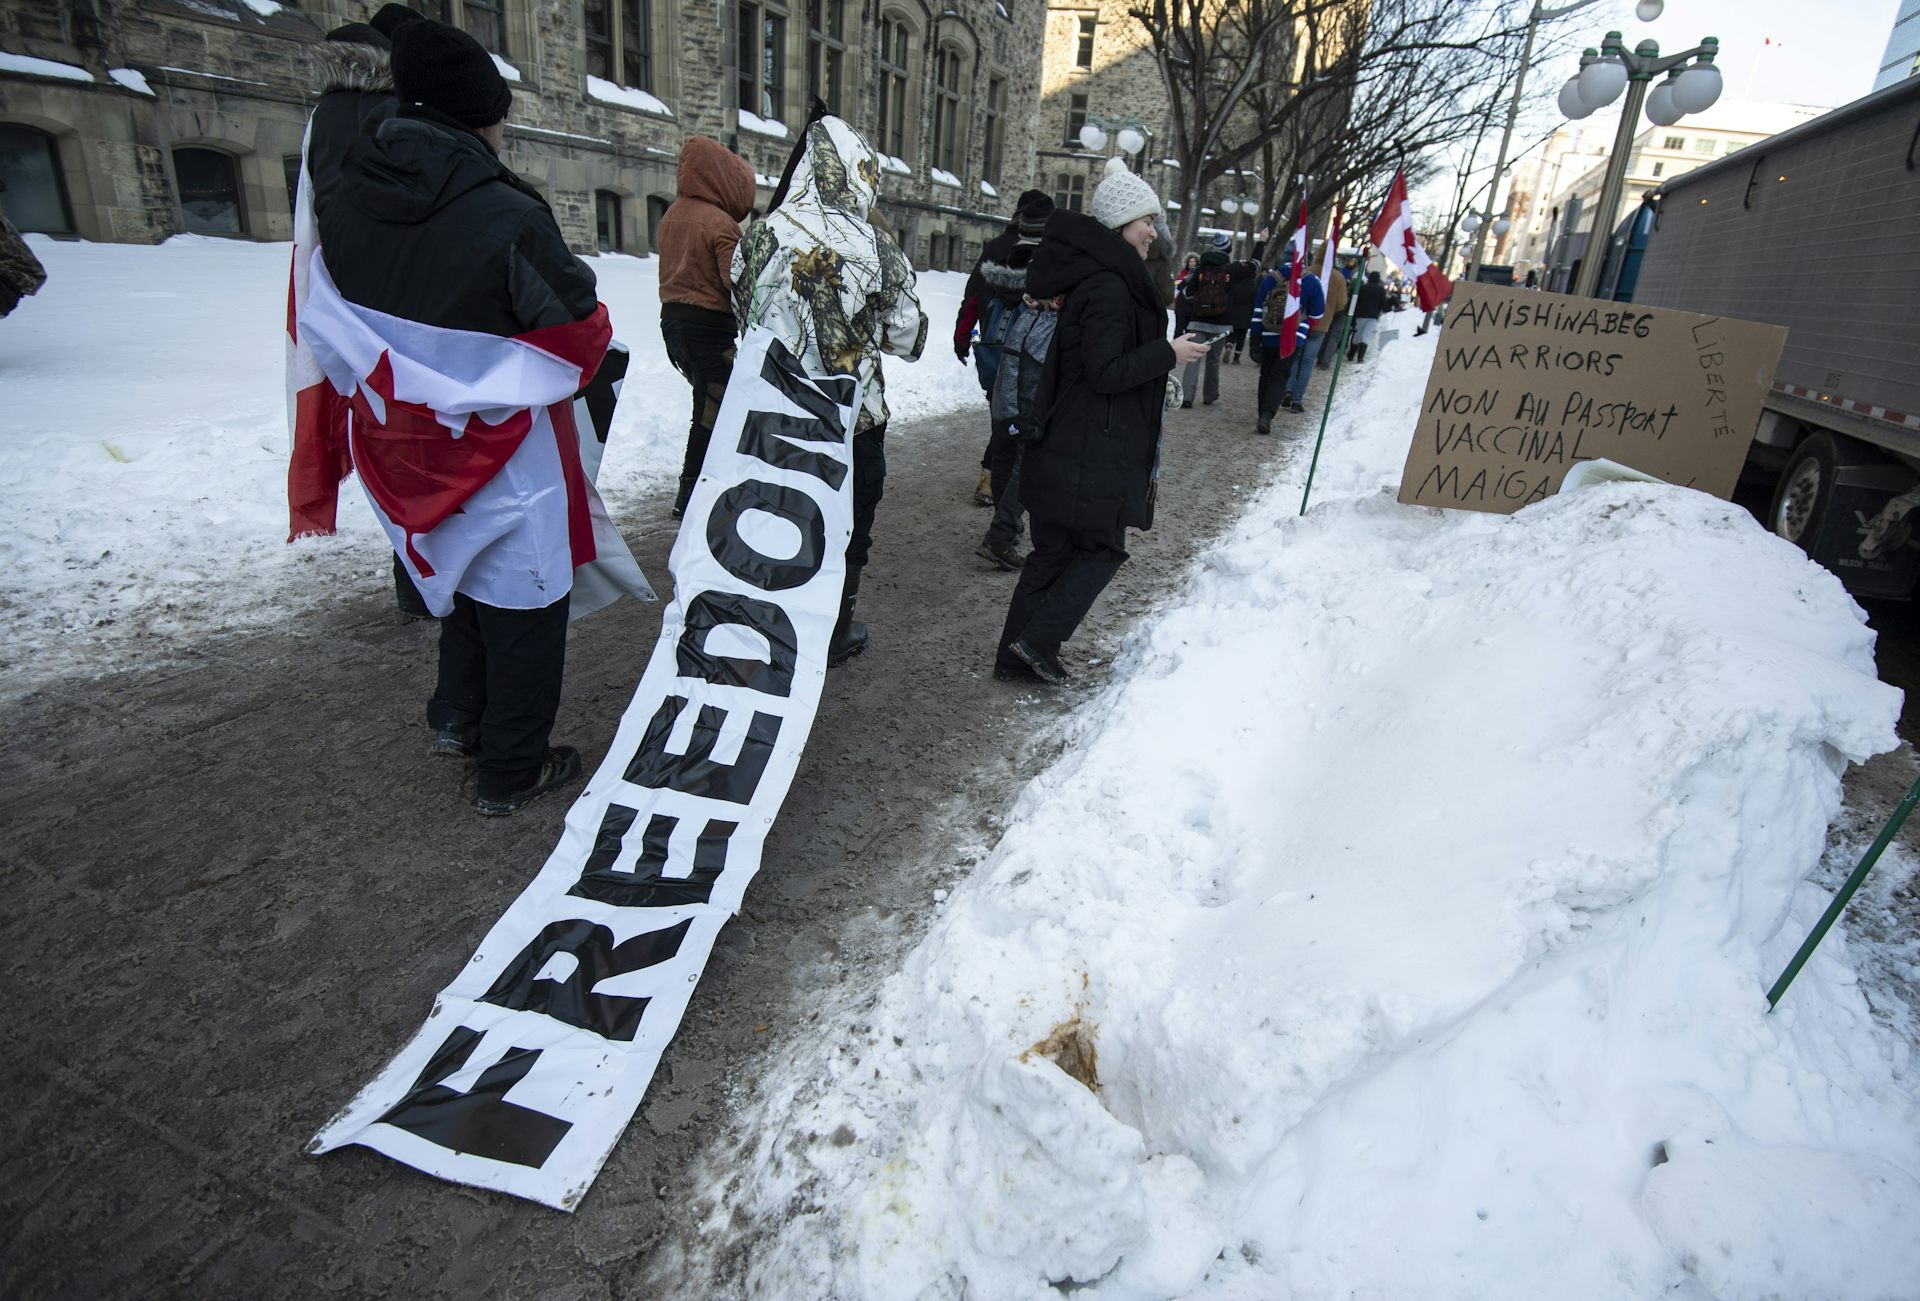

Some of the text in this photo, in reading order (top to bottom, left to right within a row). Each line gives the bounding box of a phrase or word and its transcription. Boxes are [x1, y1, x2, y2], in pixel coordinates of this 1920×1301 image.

[1446, 345, 1623, 376] WARRIORS
[1429, 388, 1499, 415] NON
[1515, 391, 1550, 426] AU
[1436, 419, 1593, 464] VACCINAL
[370, 338, 856, 1169] FREEDOM
